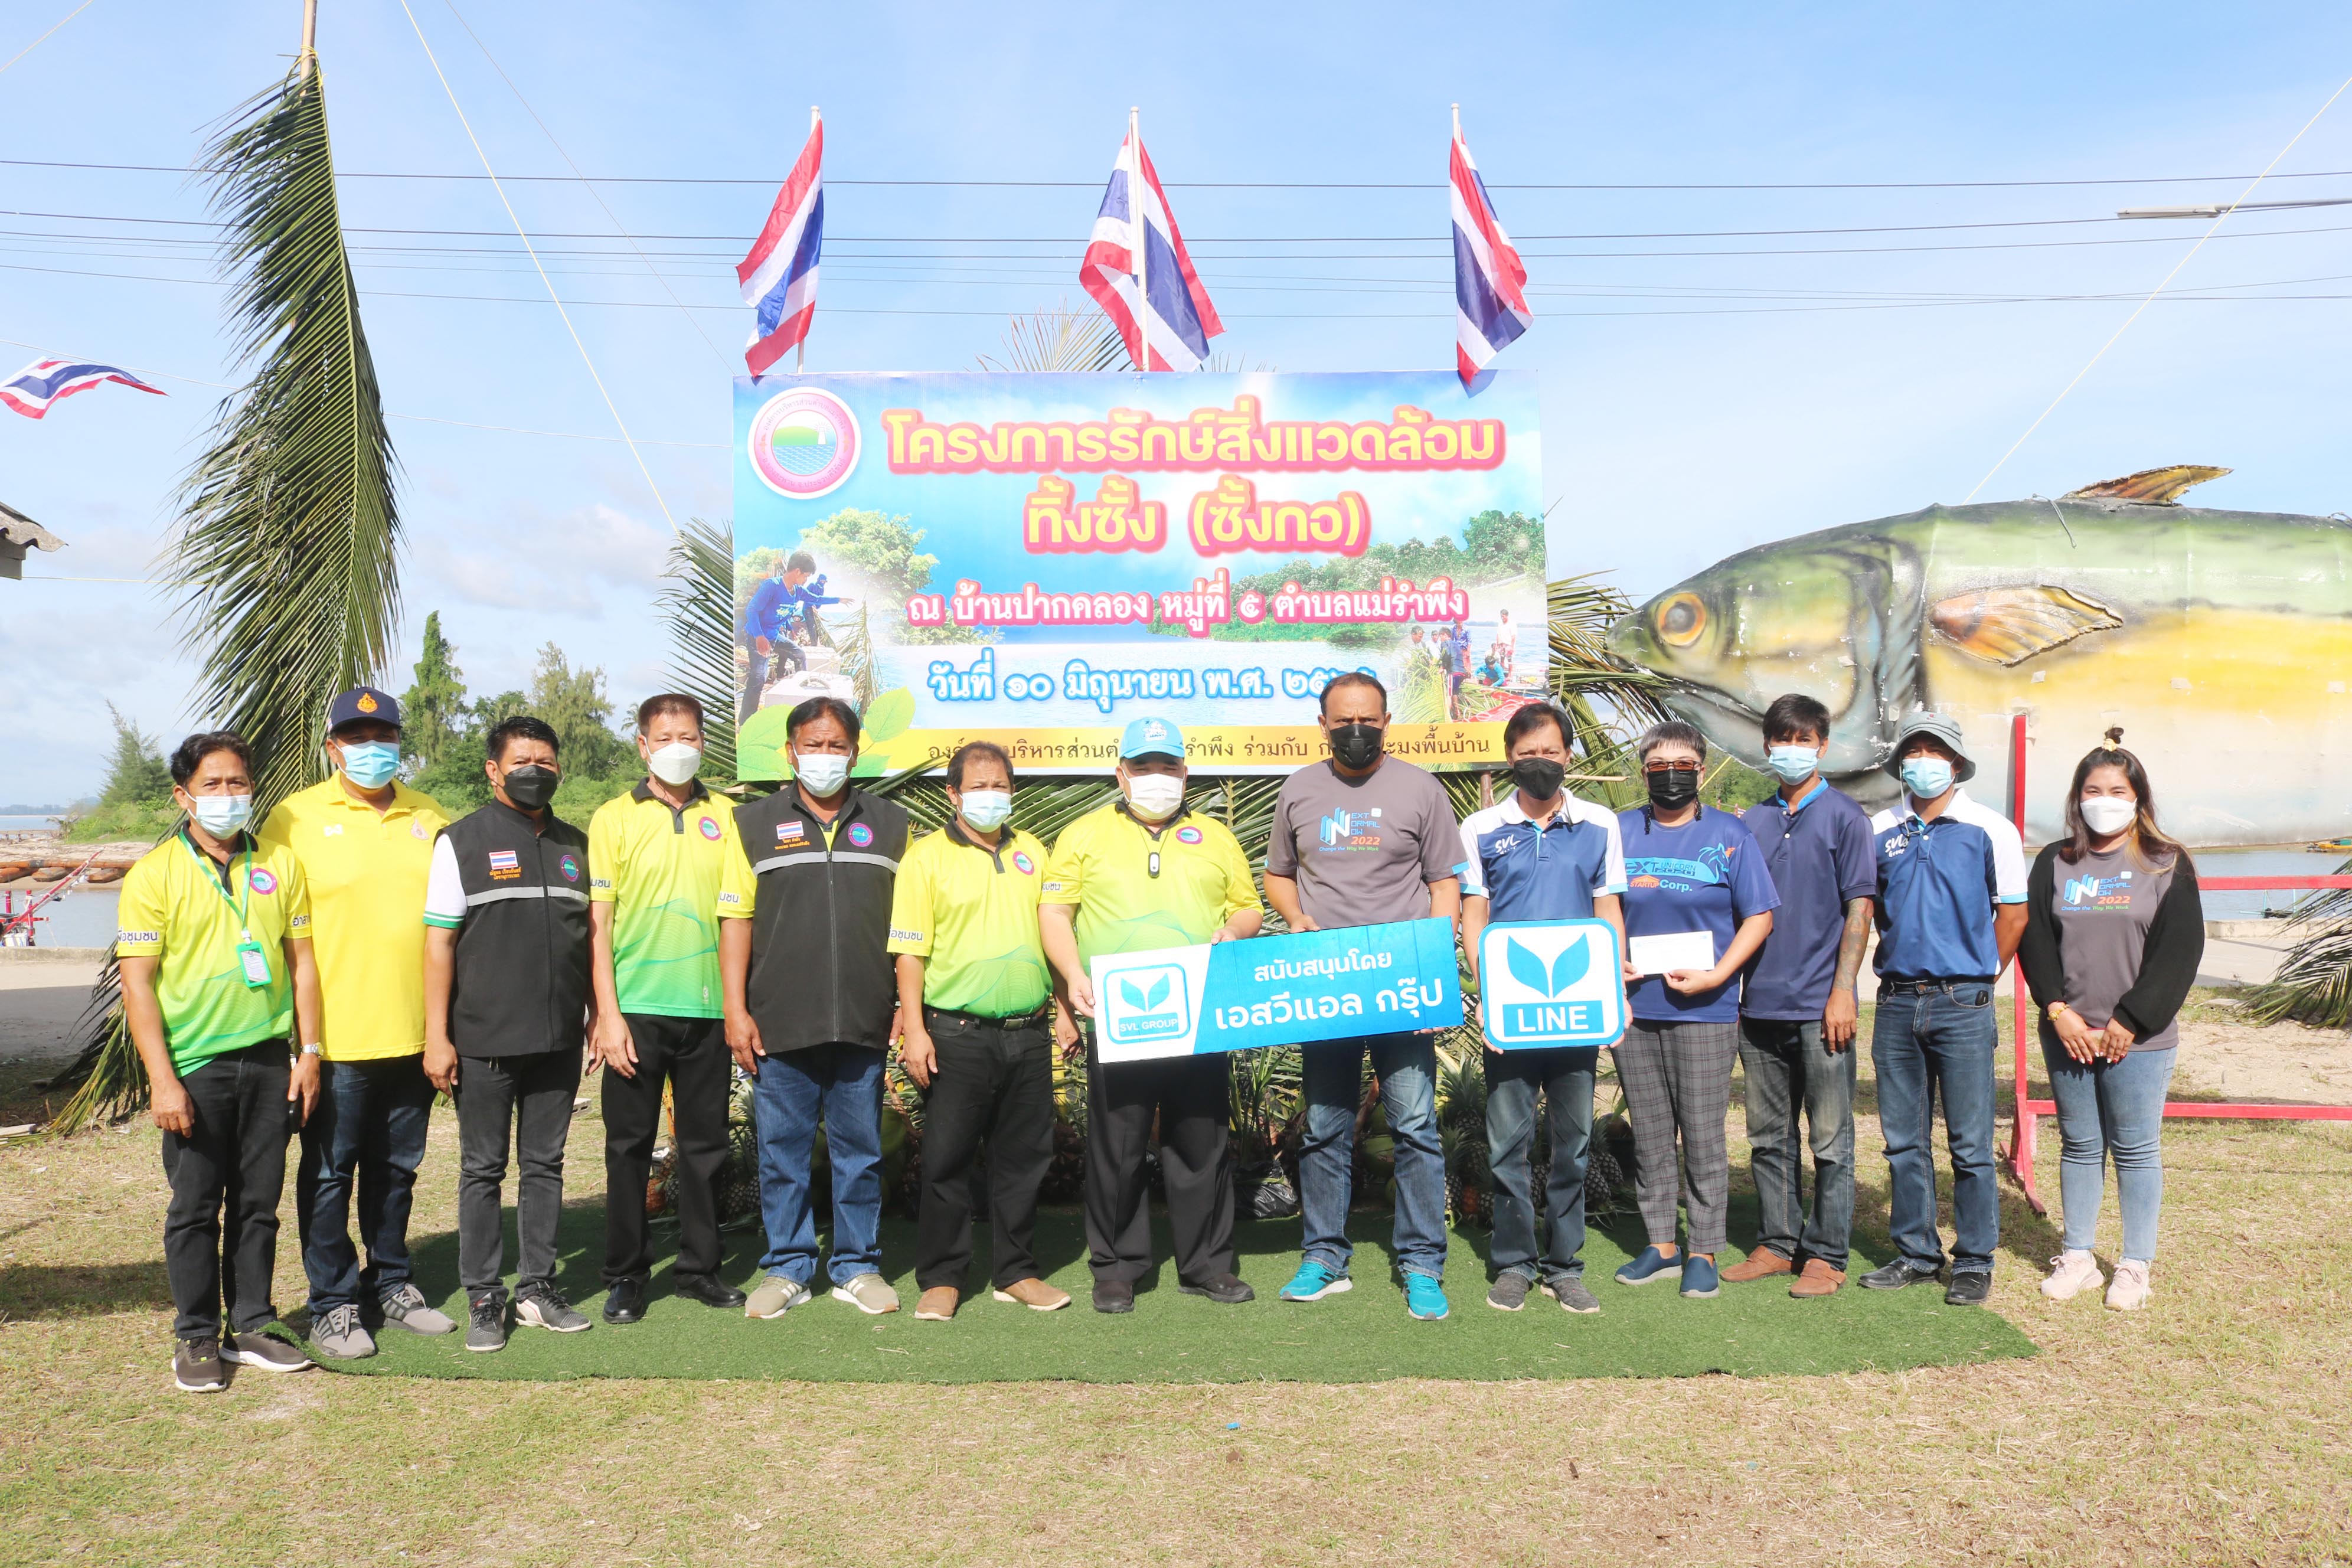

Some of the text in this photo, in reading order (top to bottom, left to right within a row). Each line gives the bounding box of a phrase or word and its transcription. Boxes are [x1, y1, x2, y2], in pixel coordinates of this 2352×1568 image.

[886, 398, 1498, 465] โครงการรักษ์สิ่งแวดล้อม
[1027, 478, 1362, 548] ทิ้งซั้ง (ซั้งกอ)
[909, 570, 1464, 632] ณ บ้านปากคลอง หมู่ที่ ๕ ตำบลแม่รำพึง
[929, 649, 992, 699] วันที่
[1005, 675, 1053, 697] ๑๐
[1066, 661, 1193, 710] มิถุนายน
[1205, 668, 1272, 695] พ.ศ.
[1244, 736, 1307, 756] ร่วมกับ
[1351, 836, 1380, 845] 2022
[1495, 834, 1521, 853] SVL
[1624, 861, 1696, 874] EXT UNICORN
[1655, 868, 1696, 877] 2020
[1660, 879, 1693, 892] Corp.
[2097, 896, 2131, 904] 2022
[1253, 946, 1393, 982] สนับสนุนโดย
[1215, 976, 1444, 1031] เอสวีแอล กรุ๊ป
[1119, 1018, 1178, 1033] SVL GROUP
[1517, 1005, 1589, 1033] LINE
